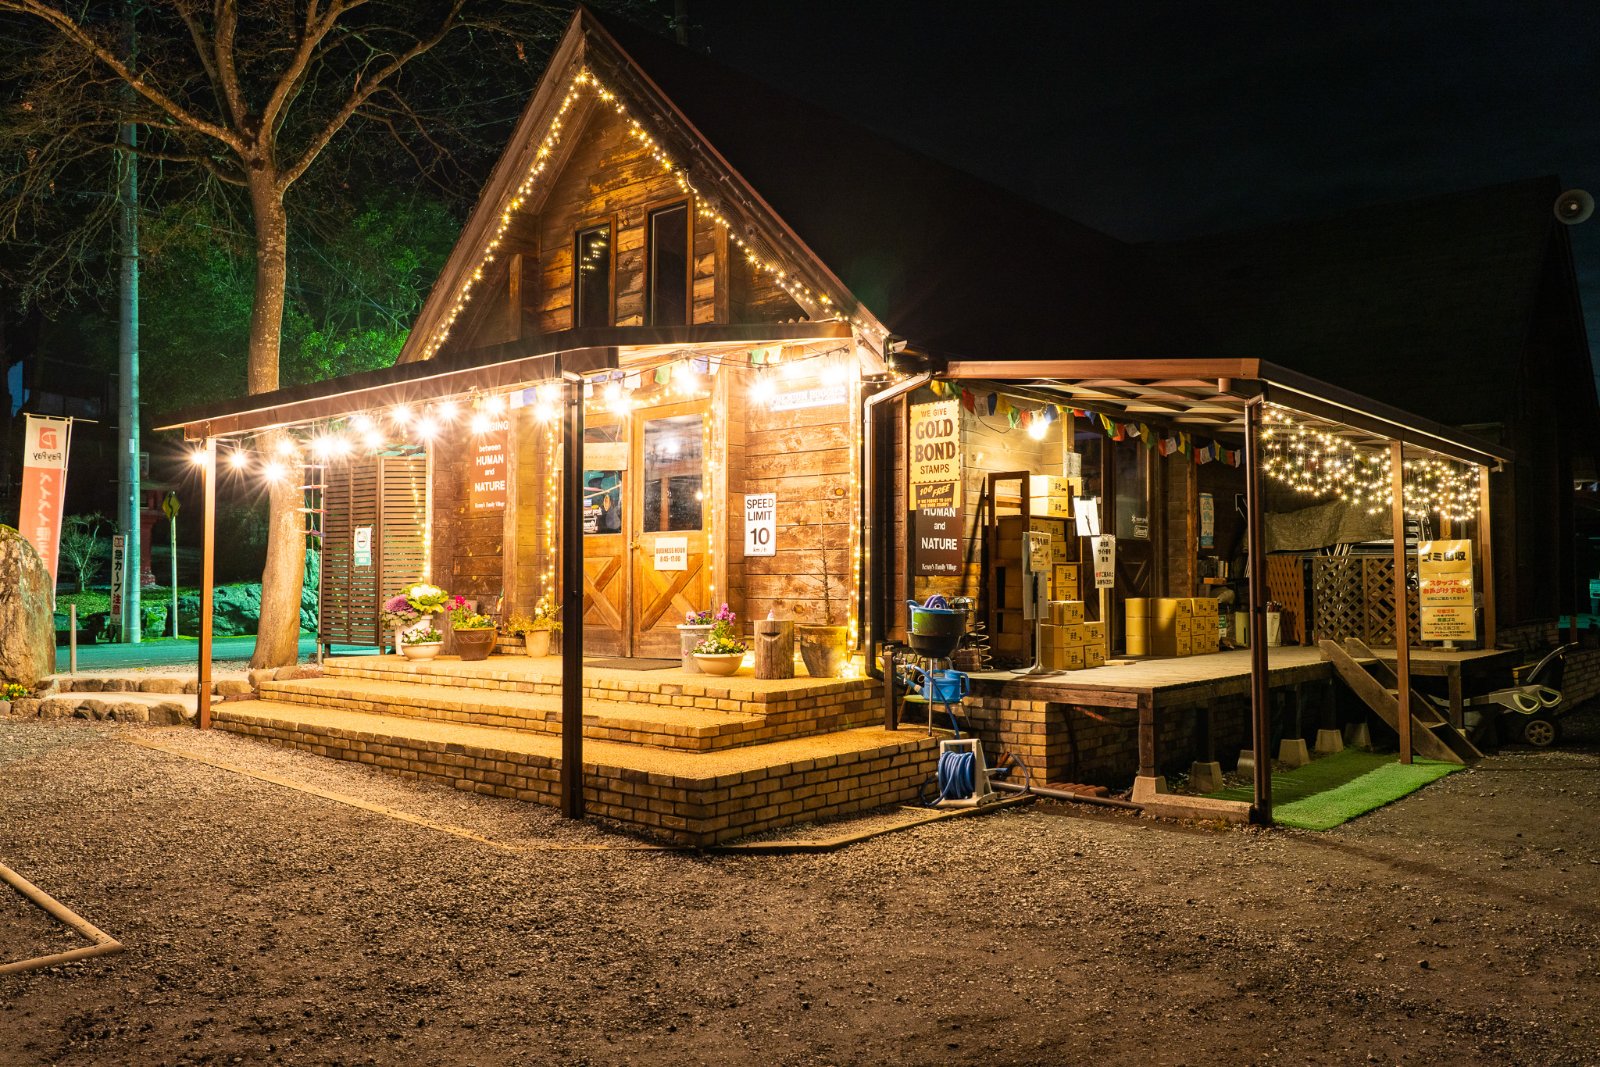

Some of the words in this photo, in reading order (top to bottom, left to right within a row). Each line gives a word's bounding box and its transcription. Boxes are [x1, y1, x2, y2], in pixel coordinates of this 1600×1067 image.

[921, 409, 931, 418] WE
[933, 407, 947, 417] GIVE
[915, 418, 954, 440] GOLD
[478, 444, 501, 453] between
[915, 441, 956, 463] BOND
[476, 454, 504, 466] HUMAN
[484, 468, 495, 476] and
[920, 463, 950, 475] STAMPS
[474, 480, 506, 492] NATURE
[920, 484, 933, 496] 100
[932, 484, 951, 498] FREE
[746, 498, 774, 509] SPEED
[747, 510, 773, 521] LIMIT
[923, 507, 956, 517] HUMAN
[933, 522, 946, 530] and
[750, 527, 770, 545] 10
[921, 537, 957, 550] NATURE
